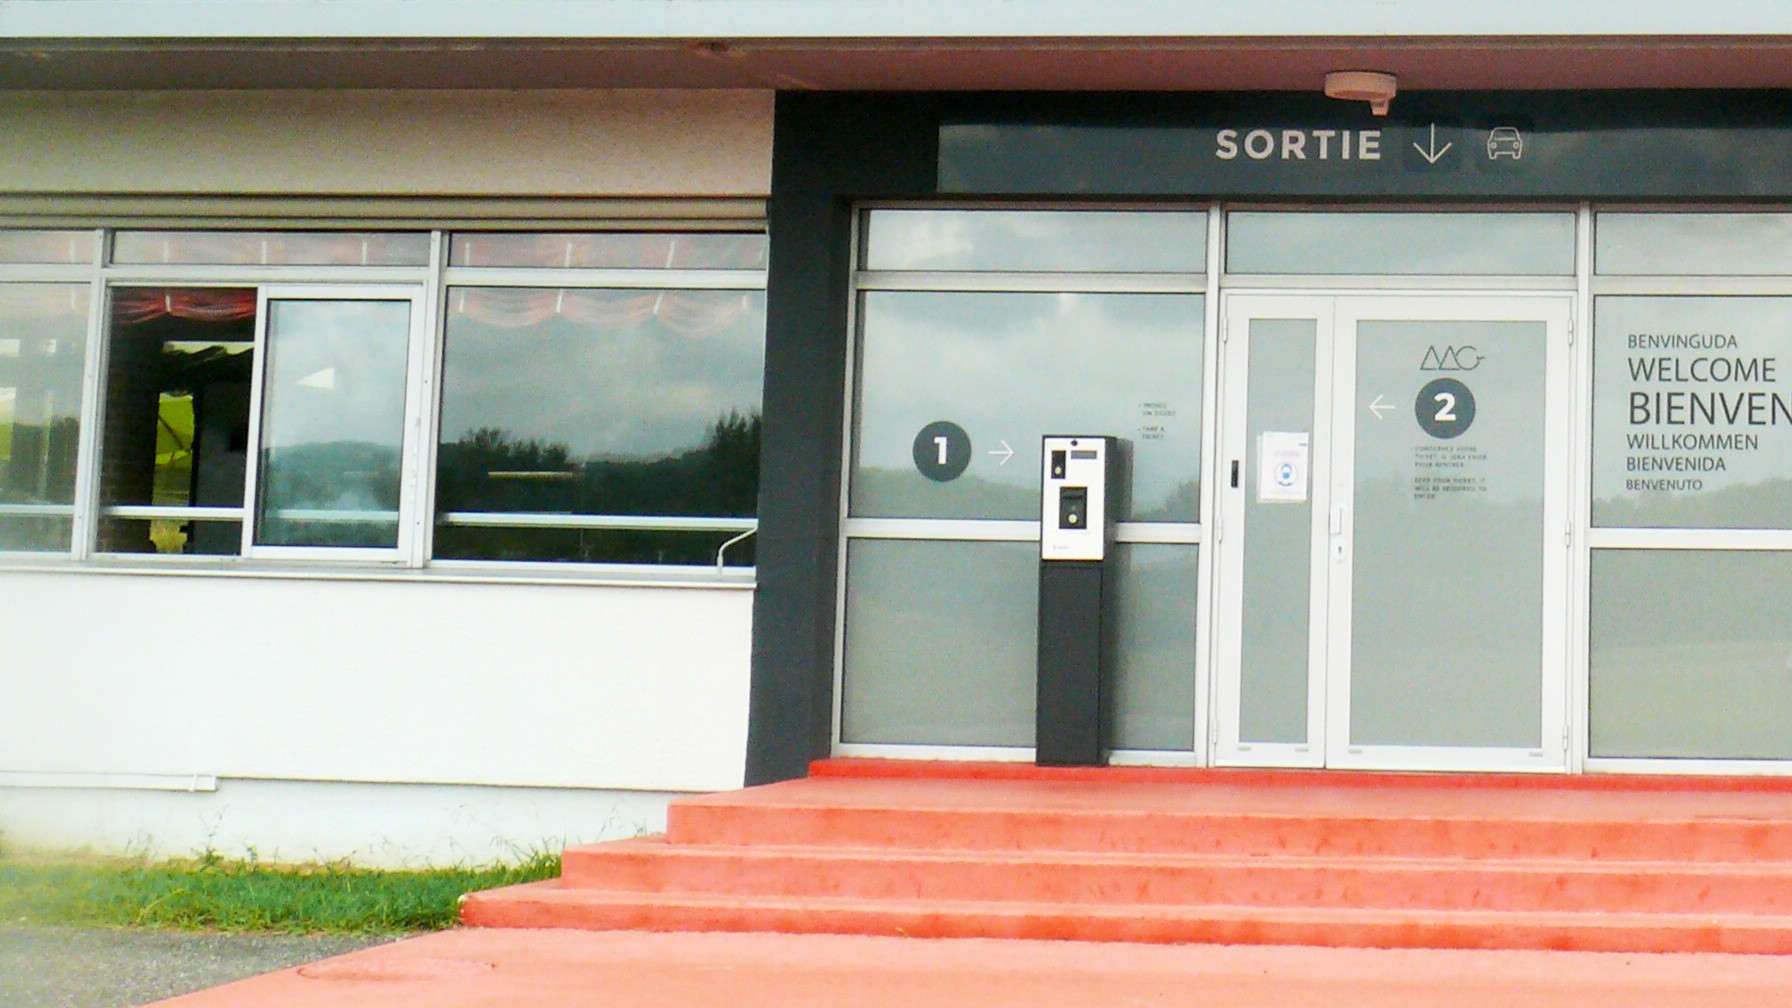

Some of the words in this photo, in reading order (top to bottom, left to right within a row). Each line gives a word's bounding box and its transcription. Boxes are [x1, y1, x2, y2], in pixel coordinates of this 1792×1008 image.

[1215, 129, 1382, 160] SORTIE
[1627, 333, 1738, 350] BENVINGUDA
[1627, 357, 1777, 383] WELCOME
[1433, 392, 1457, 421] 2
[933, 436, 948, 465] 1
[1626, 433, 1758, 450] WILLKOMMEN
[1626, 456, 1726, 472] BIENVENIDA
[1626, 479, 1703, 491] BENVENUTO
